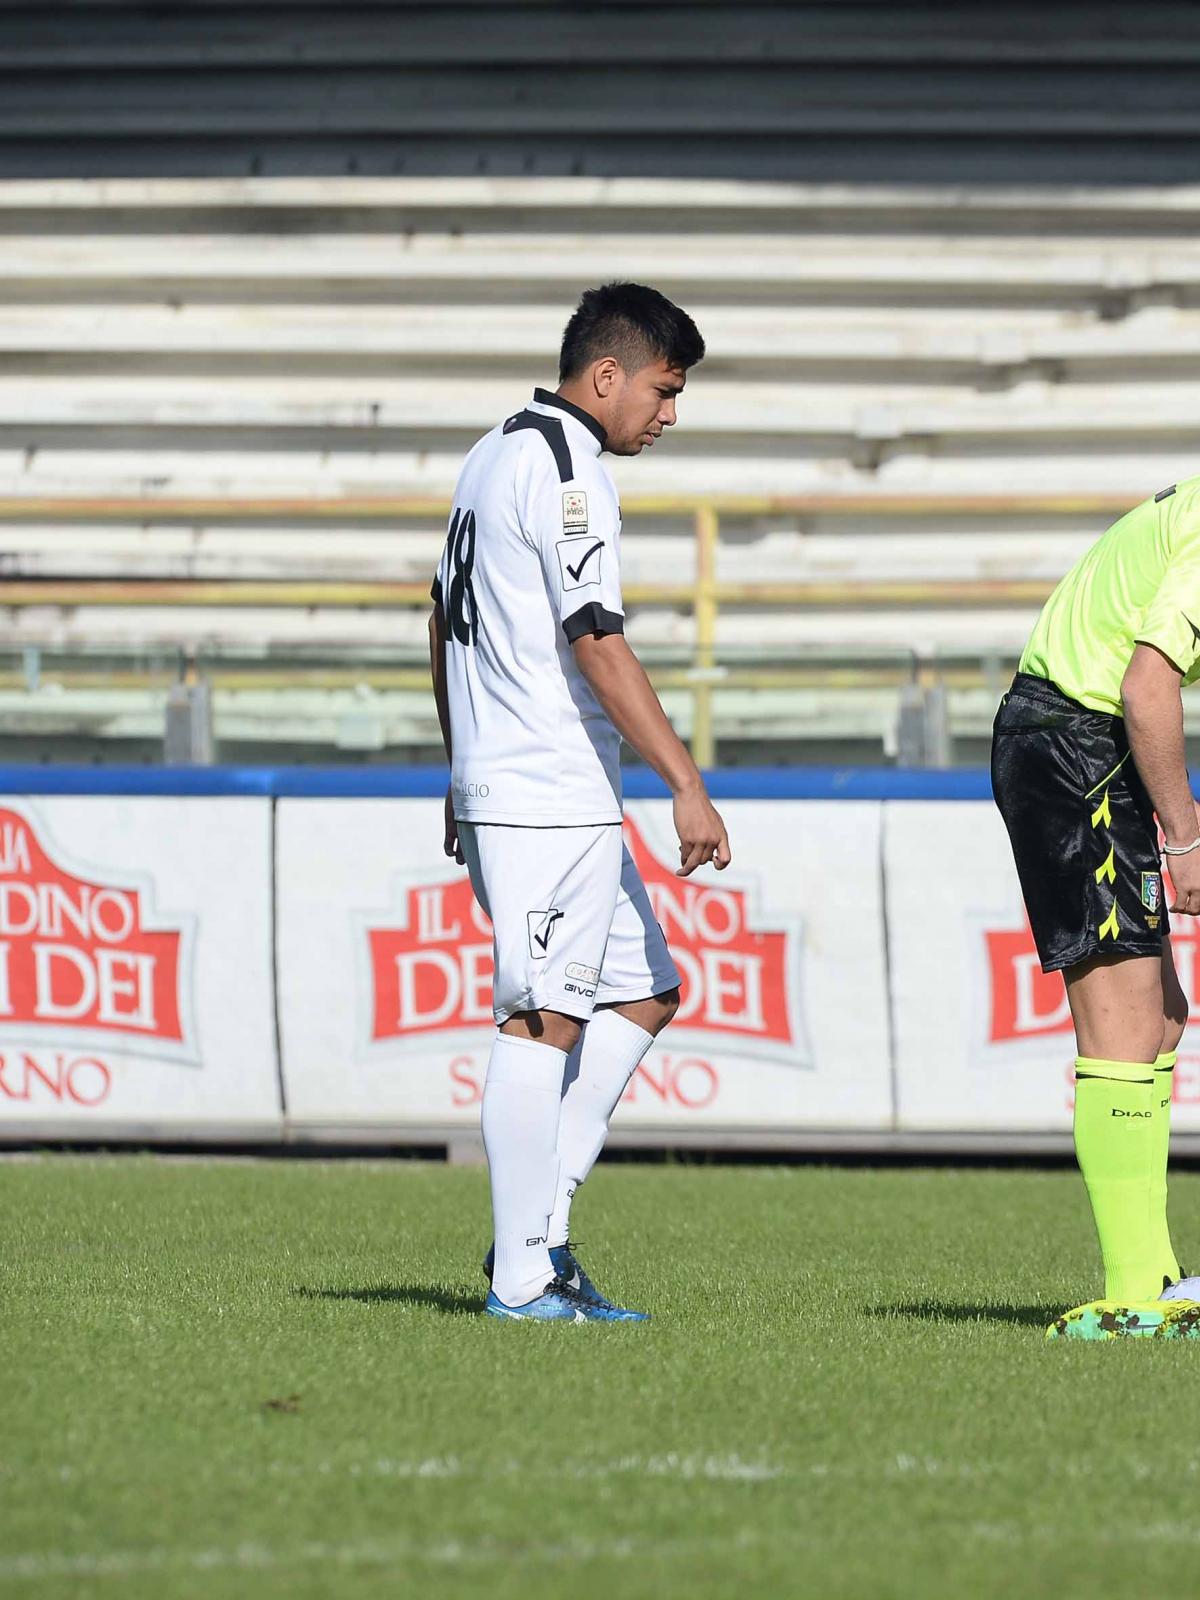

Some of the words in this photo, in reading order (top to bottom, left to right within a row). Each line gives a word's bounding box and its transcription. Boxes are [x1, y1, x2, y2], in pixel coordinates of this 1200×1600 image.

[446, 508, 479, 647] 18
[417, 887, 462, 943] IL
[32, 942, 157, 1028] DEI
[565, 983, 594, 998] GIVO
[1112, 1109, 1152, 1118] DIAD
[526, 1236, 548, 1246] GIV
